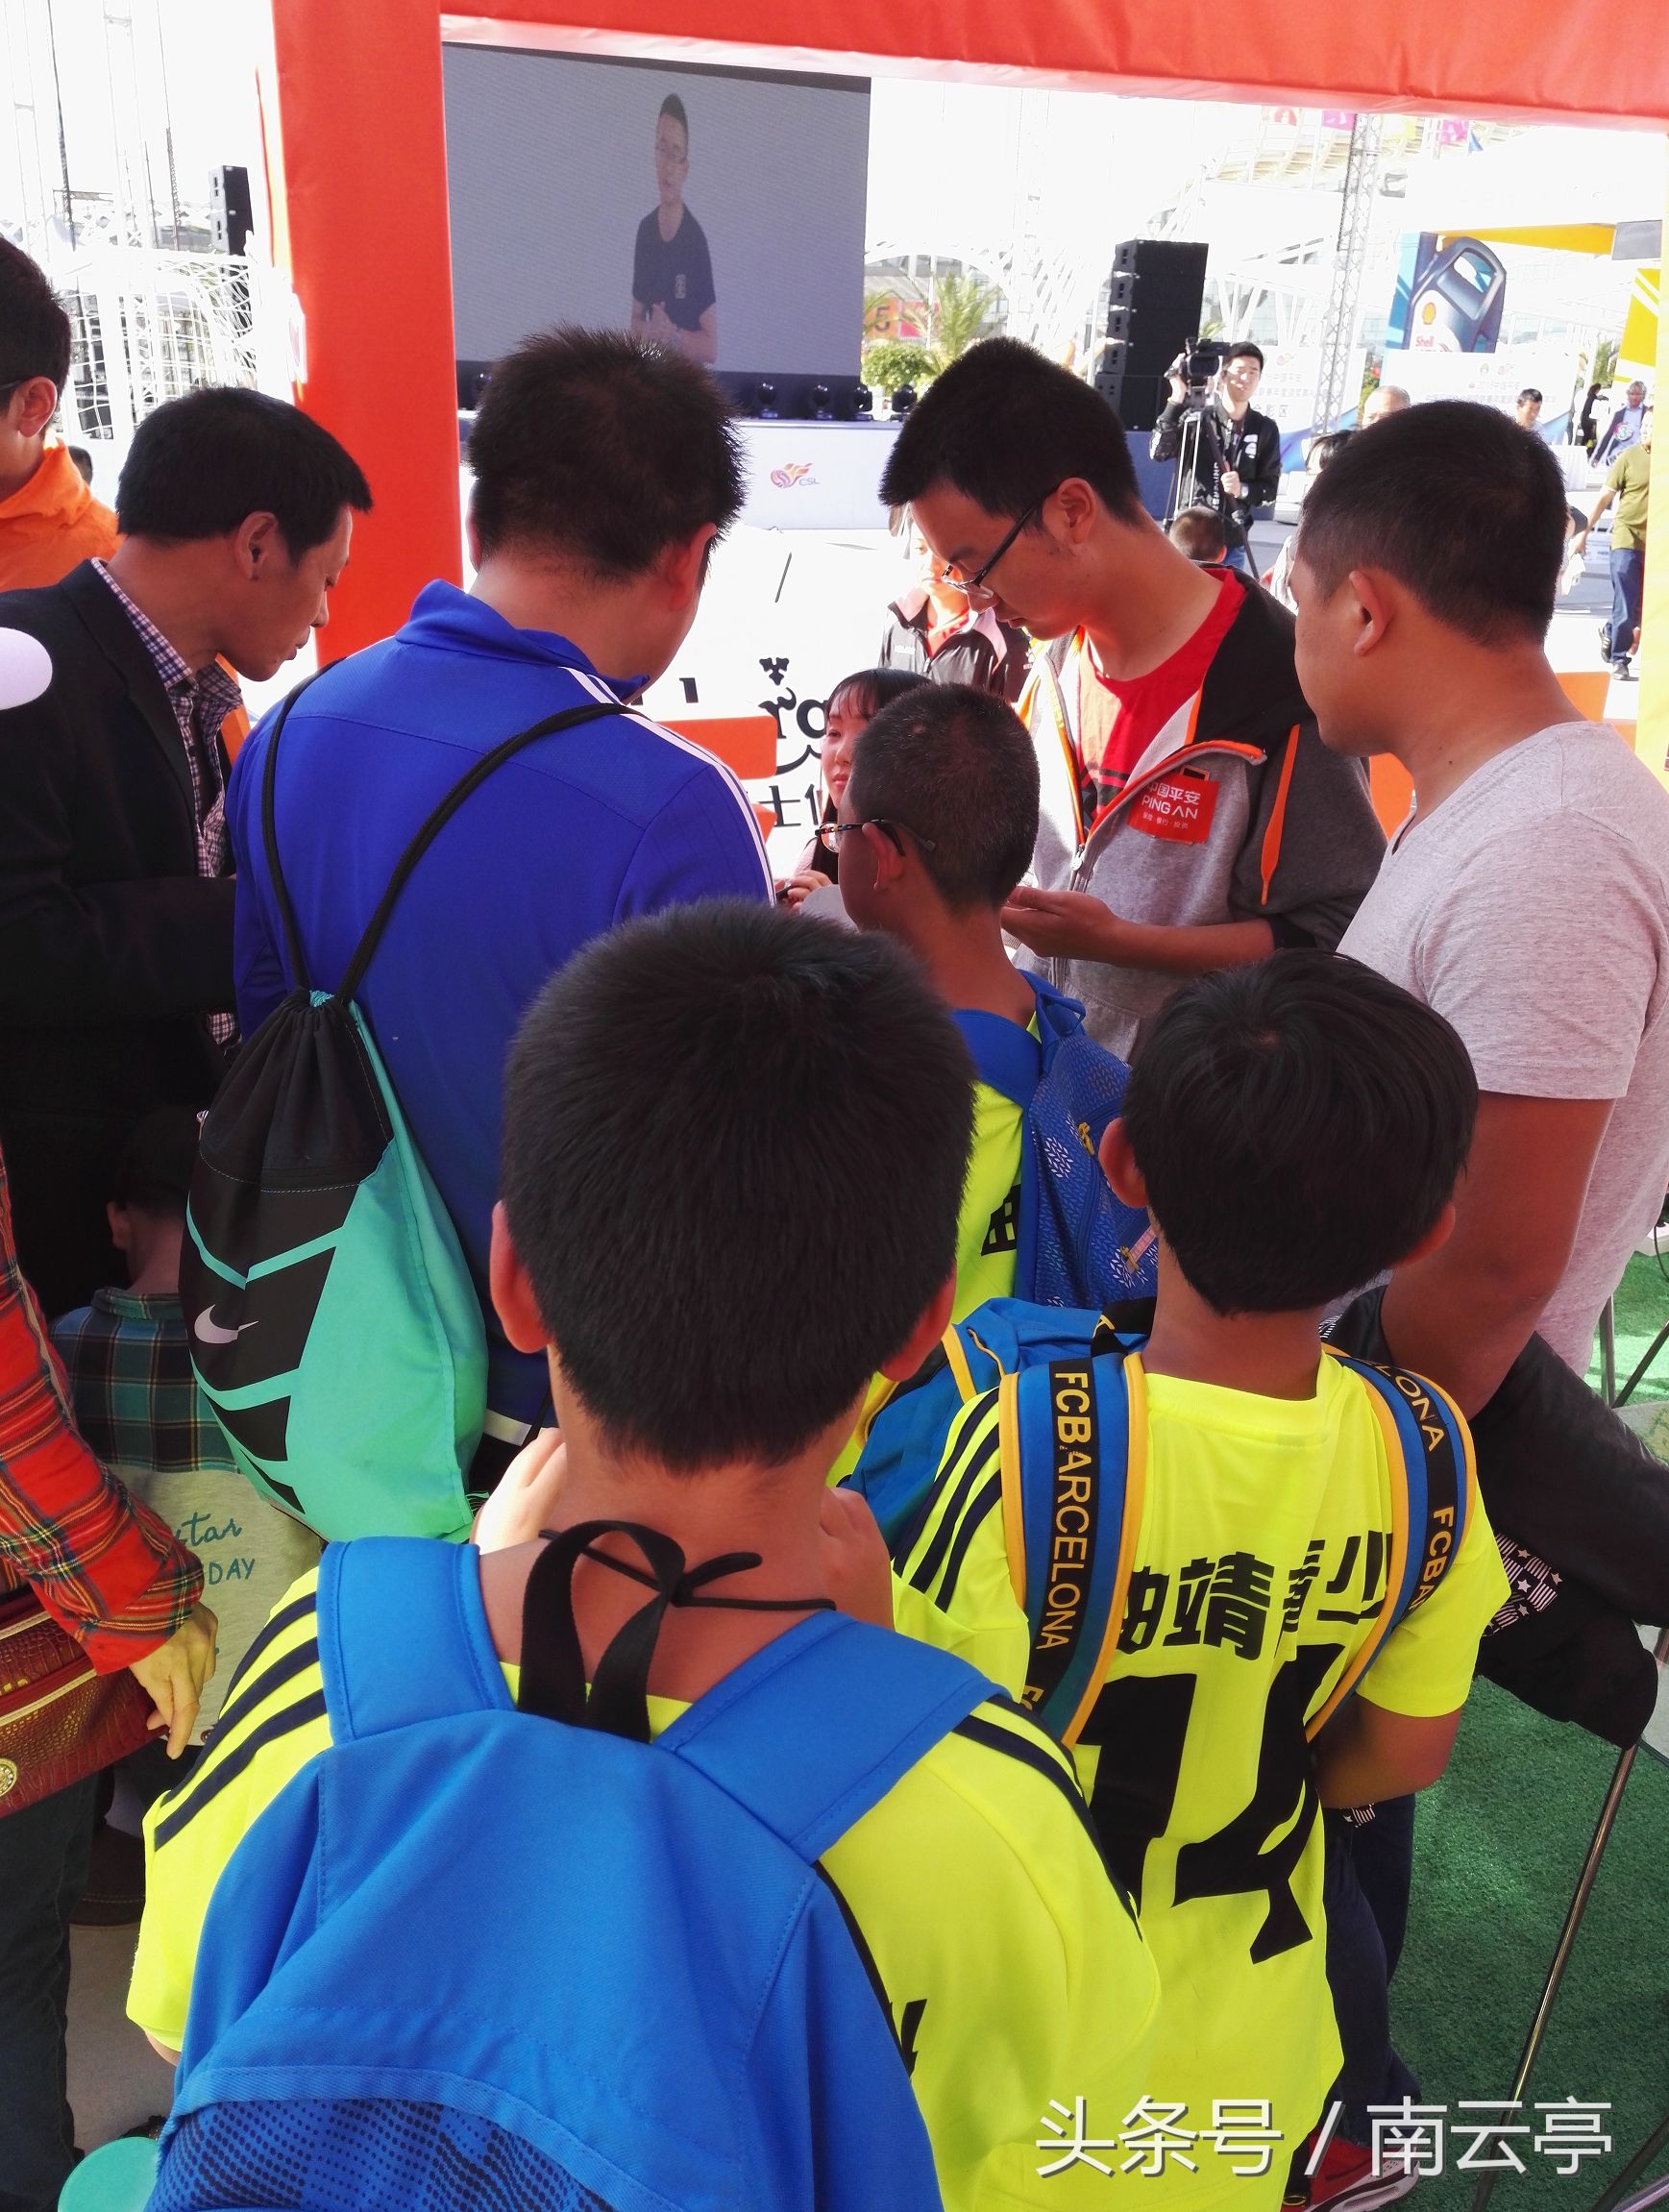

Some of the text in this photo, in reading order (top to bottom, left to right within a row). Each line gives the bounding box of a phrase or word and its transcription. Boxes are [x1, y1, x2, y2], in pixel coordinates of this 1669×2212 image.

[1148, 781, 1201, 805] 中国平安
[1141, 794, 1199, 820] PING AN
